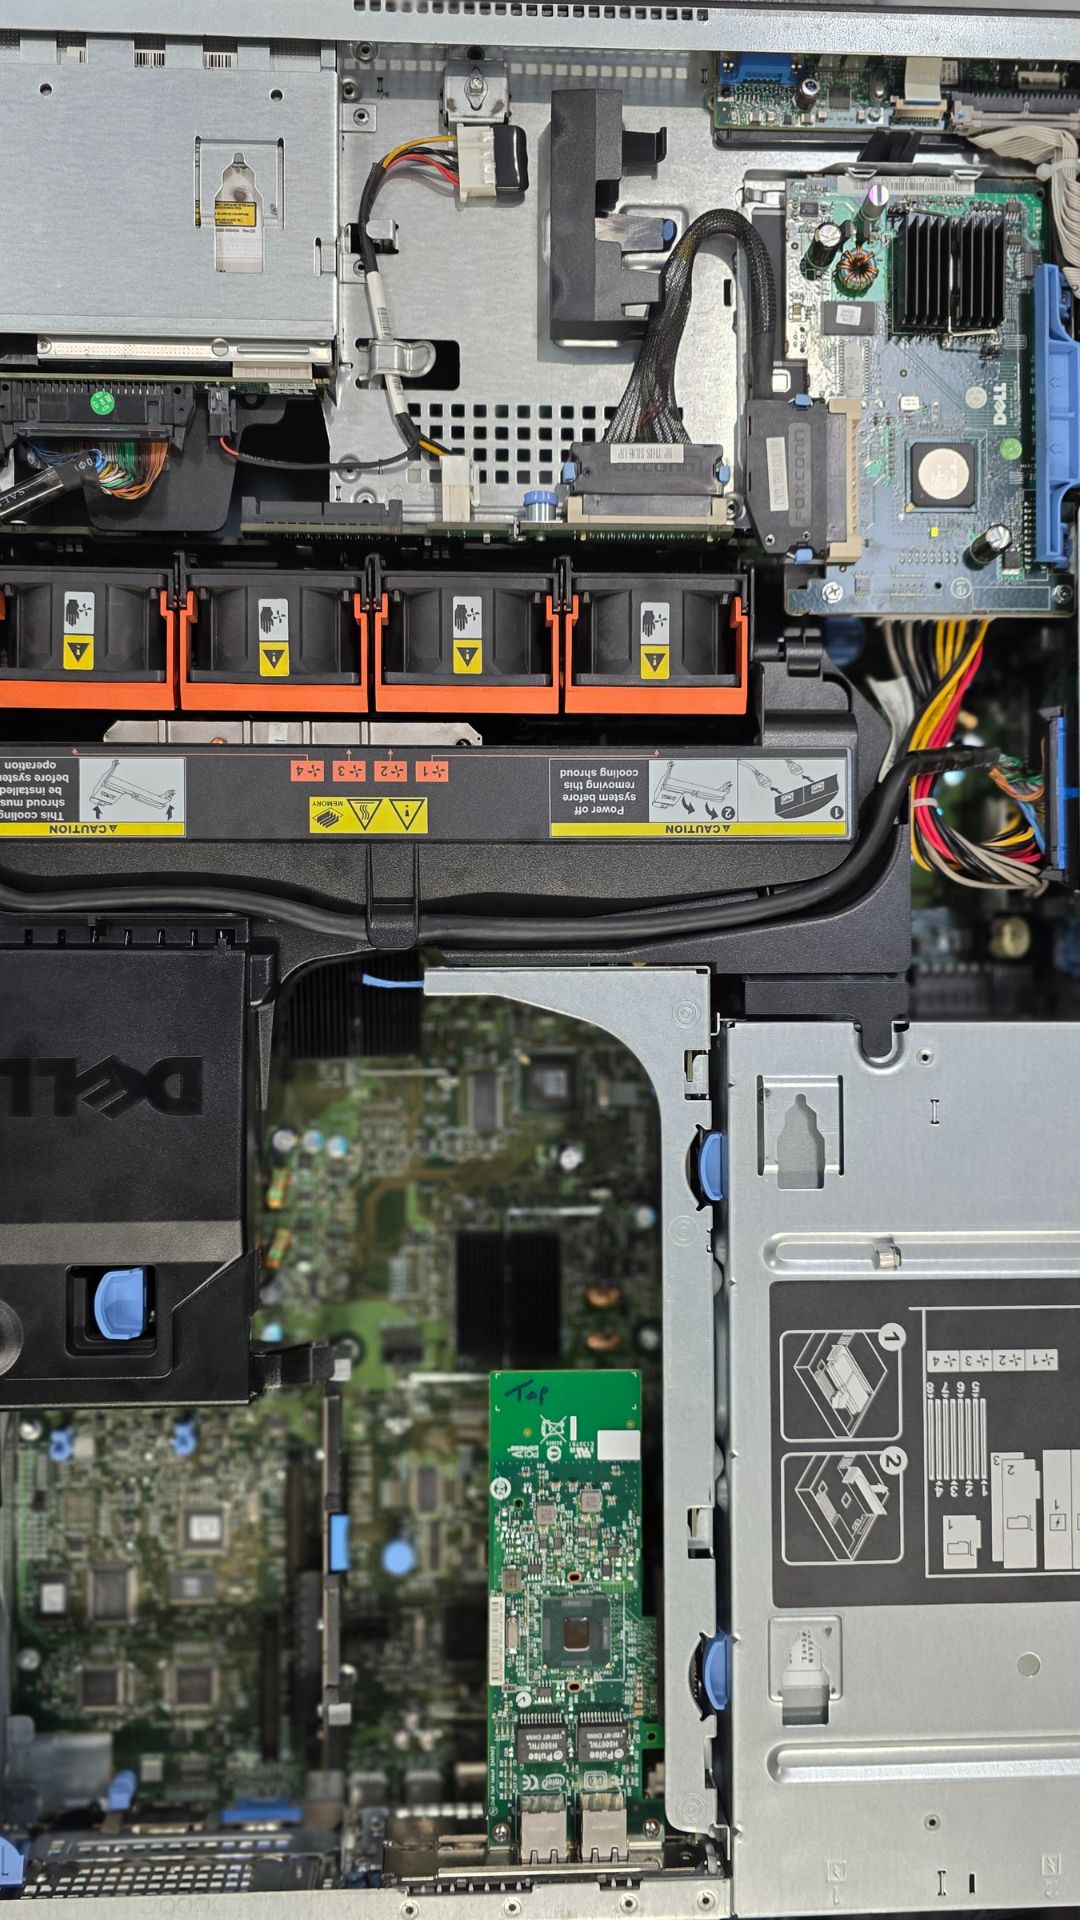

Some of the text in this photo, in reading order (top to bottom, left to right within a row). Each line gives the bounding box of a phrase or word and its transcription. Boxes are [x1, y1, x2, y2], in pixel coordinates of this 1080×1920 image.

[993, 383, 1007, 425] DELL
[618, 447, 628, 459] UP
[646, 447, 662, 459] THIS
[5, 761, 56, 770] operation
[295, 766, 304, 776] 4
[338, 766, 345, 776] 3
[381, 766, 388, 776] 2
[423, 766, 428, 776] 1
[560, 768, 639, 777] cooling shroud
[34, 774, 69, 783] before
[564, 780, 635, 790] removing this
[0, 786, 62, 796] be installed
[563, 793, 637, 802] system before
[27, 799, 65, 808] shroud
[574, 806, 625, 815] Power off
[725, 808, 732, 817] 2
[41, 812, 64, 821] This
[49, 824, 107, 833] CAUTION
[666, 825, 721, 834] CAUTION
[0, 1054, 204, 1120] DELL
[884, 1331, 900, 1341] 1
[932, 1356, 940, 1367] 4
[965, 1356, 972, 1366] 3
[999, 1355, 1006, 1365] 2
[1032, 1354, 1038, 1365] 1
[504, 1379, 549, 1405] Top
[926, 1382, 934, 1393] 8
[941, 1382, 949, 1393] 7
[957, 1381, 965, 1393] 6
[971, 1381, 980, 1393] 5
[885, 1454, 902, 1468] 2
[993, 1455, 1000, 1466] 3
[1007, 1465, 1015, 1475] 2
[935, 1485, 944, 1498] 4
[950, 1486, 958, 1497] 3
[965, 1485, 973, 1497] 2
[982, 1485, 989, 1496] 1
[1054, 1499, 1060, 1510] 1
[947, 1519, 953, 1530] 1
[528, 1751, 553, 1761] Pulse
[589, 1750, 614, 1760] Pulse
[522, 1774, 539, 1791] CE
